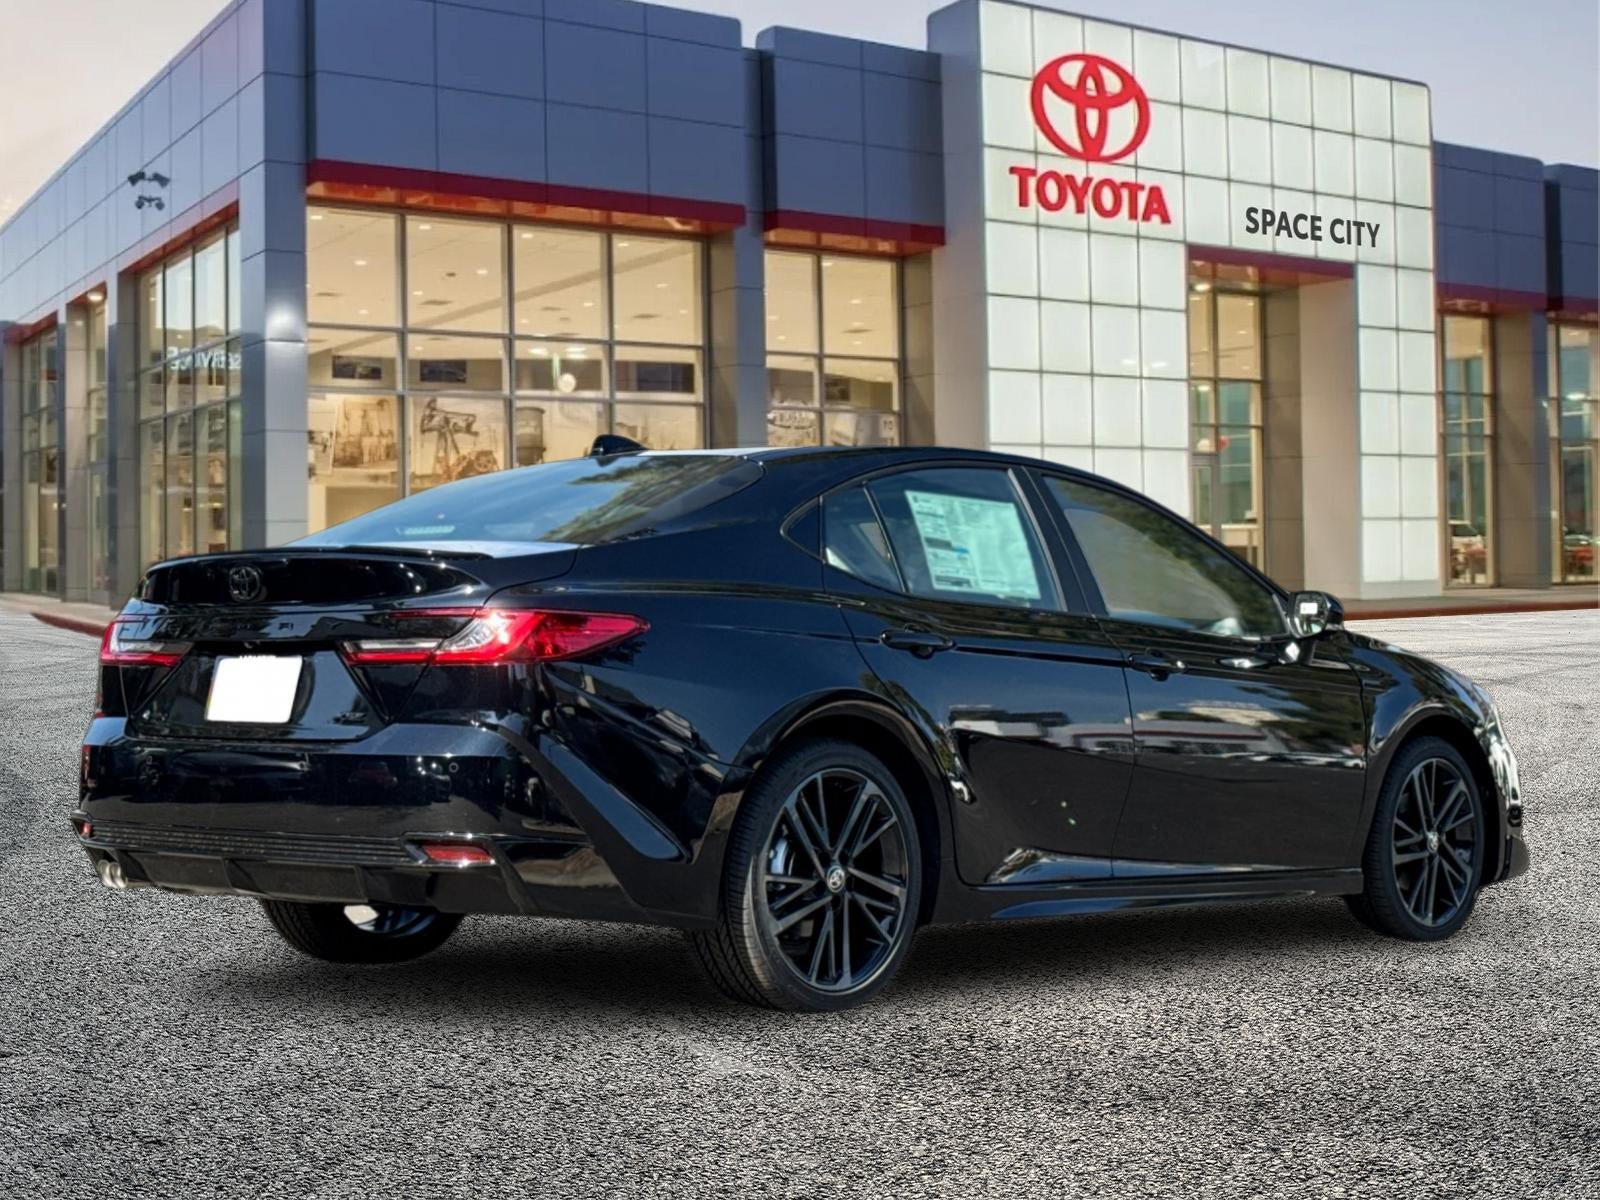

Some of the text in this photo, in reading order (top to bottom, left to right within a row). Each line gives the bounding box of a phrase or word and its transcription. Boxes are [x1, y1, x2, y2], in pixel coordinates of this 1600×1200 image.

[1009, 166, 1171, 224] TOYOTA
[1245, 206, 1380, 248] SPACE CITY
